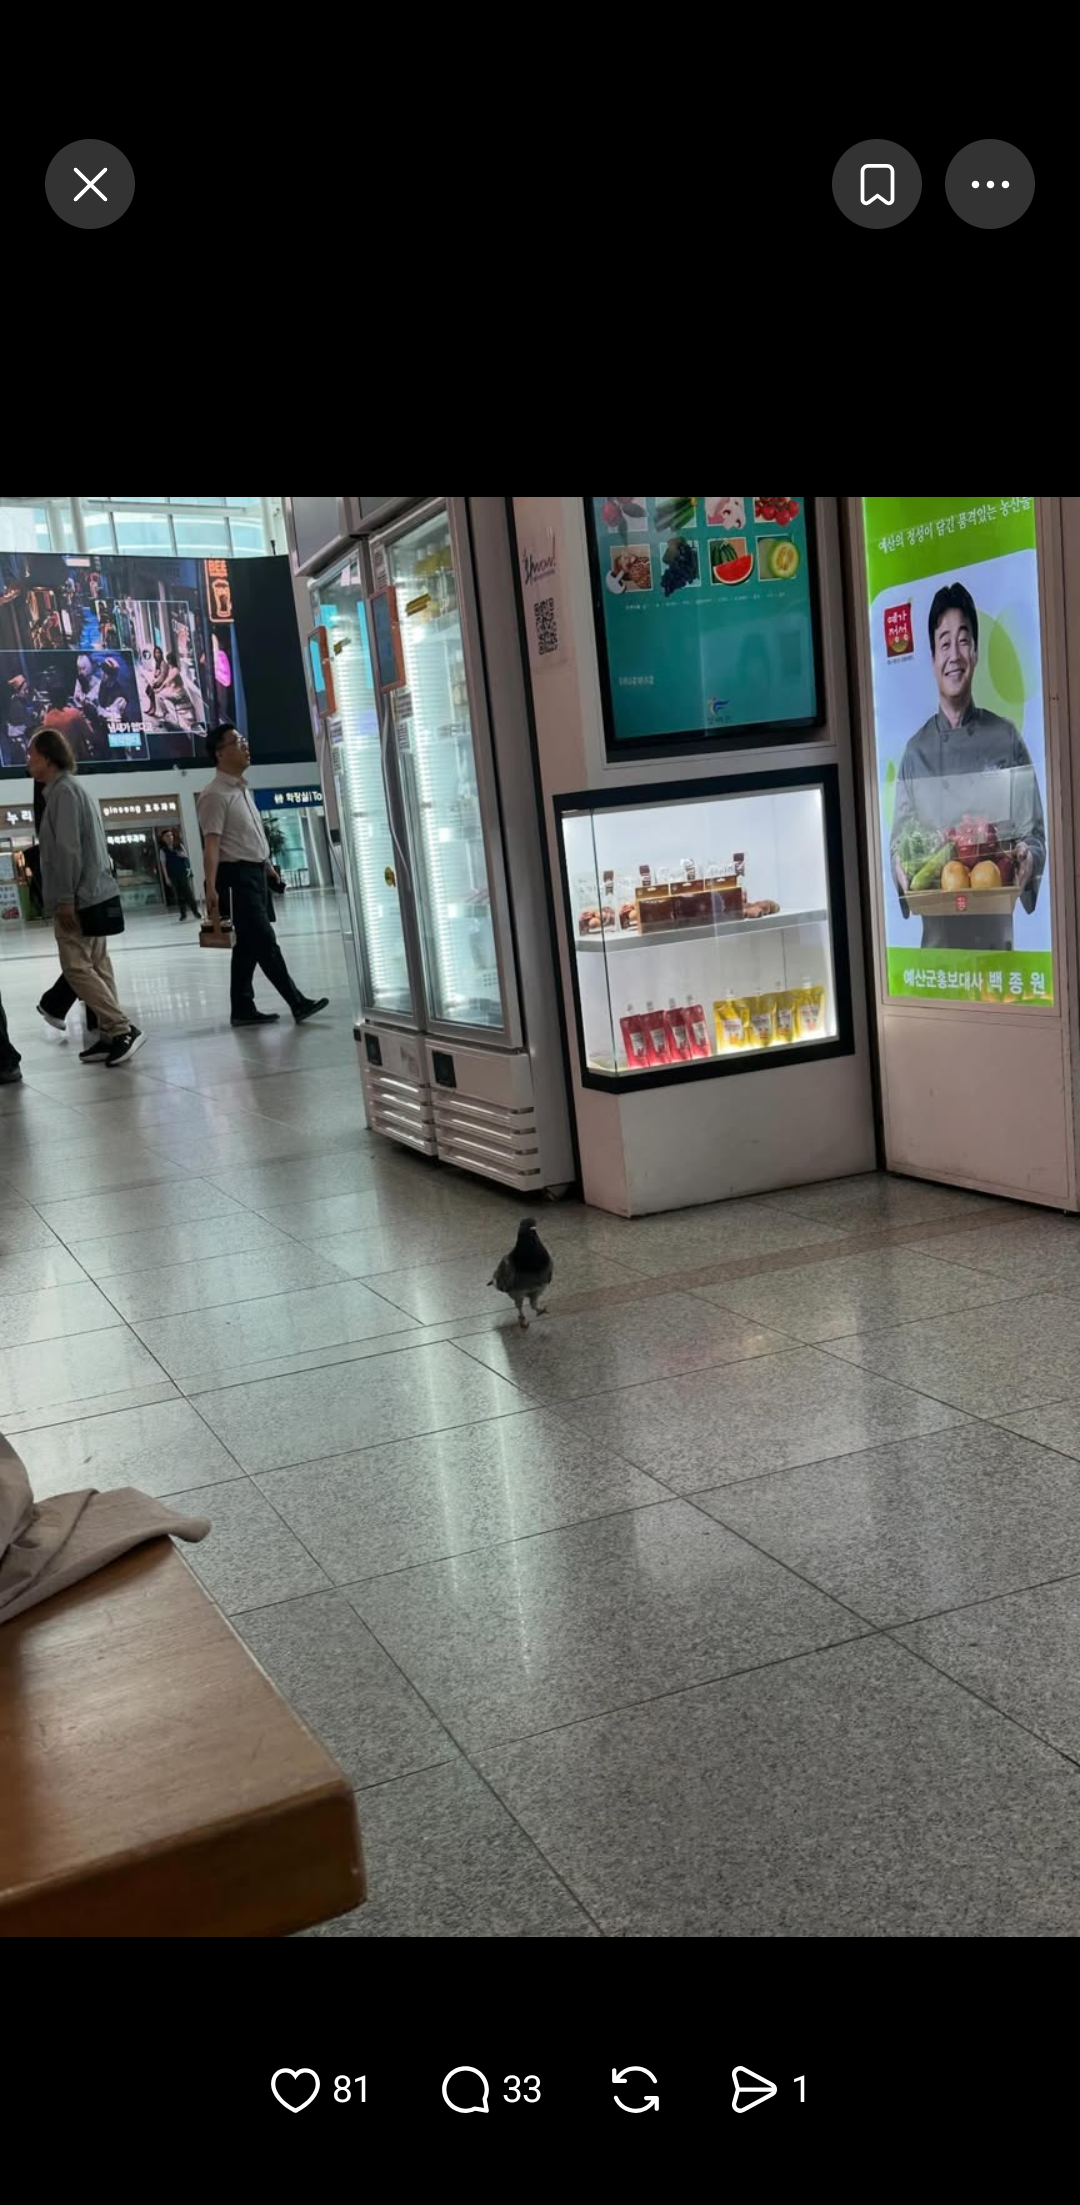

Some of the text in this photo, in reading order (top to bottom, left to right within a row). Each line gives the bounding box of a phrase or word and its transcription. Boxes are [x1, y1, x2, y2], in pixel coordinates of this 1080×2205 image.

[879, 532, 905, 554] 예산의
[907, 523, 934, 546] 정성이
[936, 515, 955, 537] 담긴
[957, 504, 998, 530] 품격있는
[286, 791, 309, 803] 화장실
[903, 968, 984, 992] 예산군홍보대사
